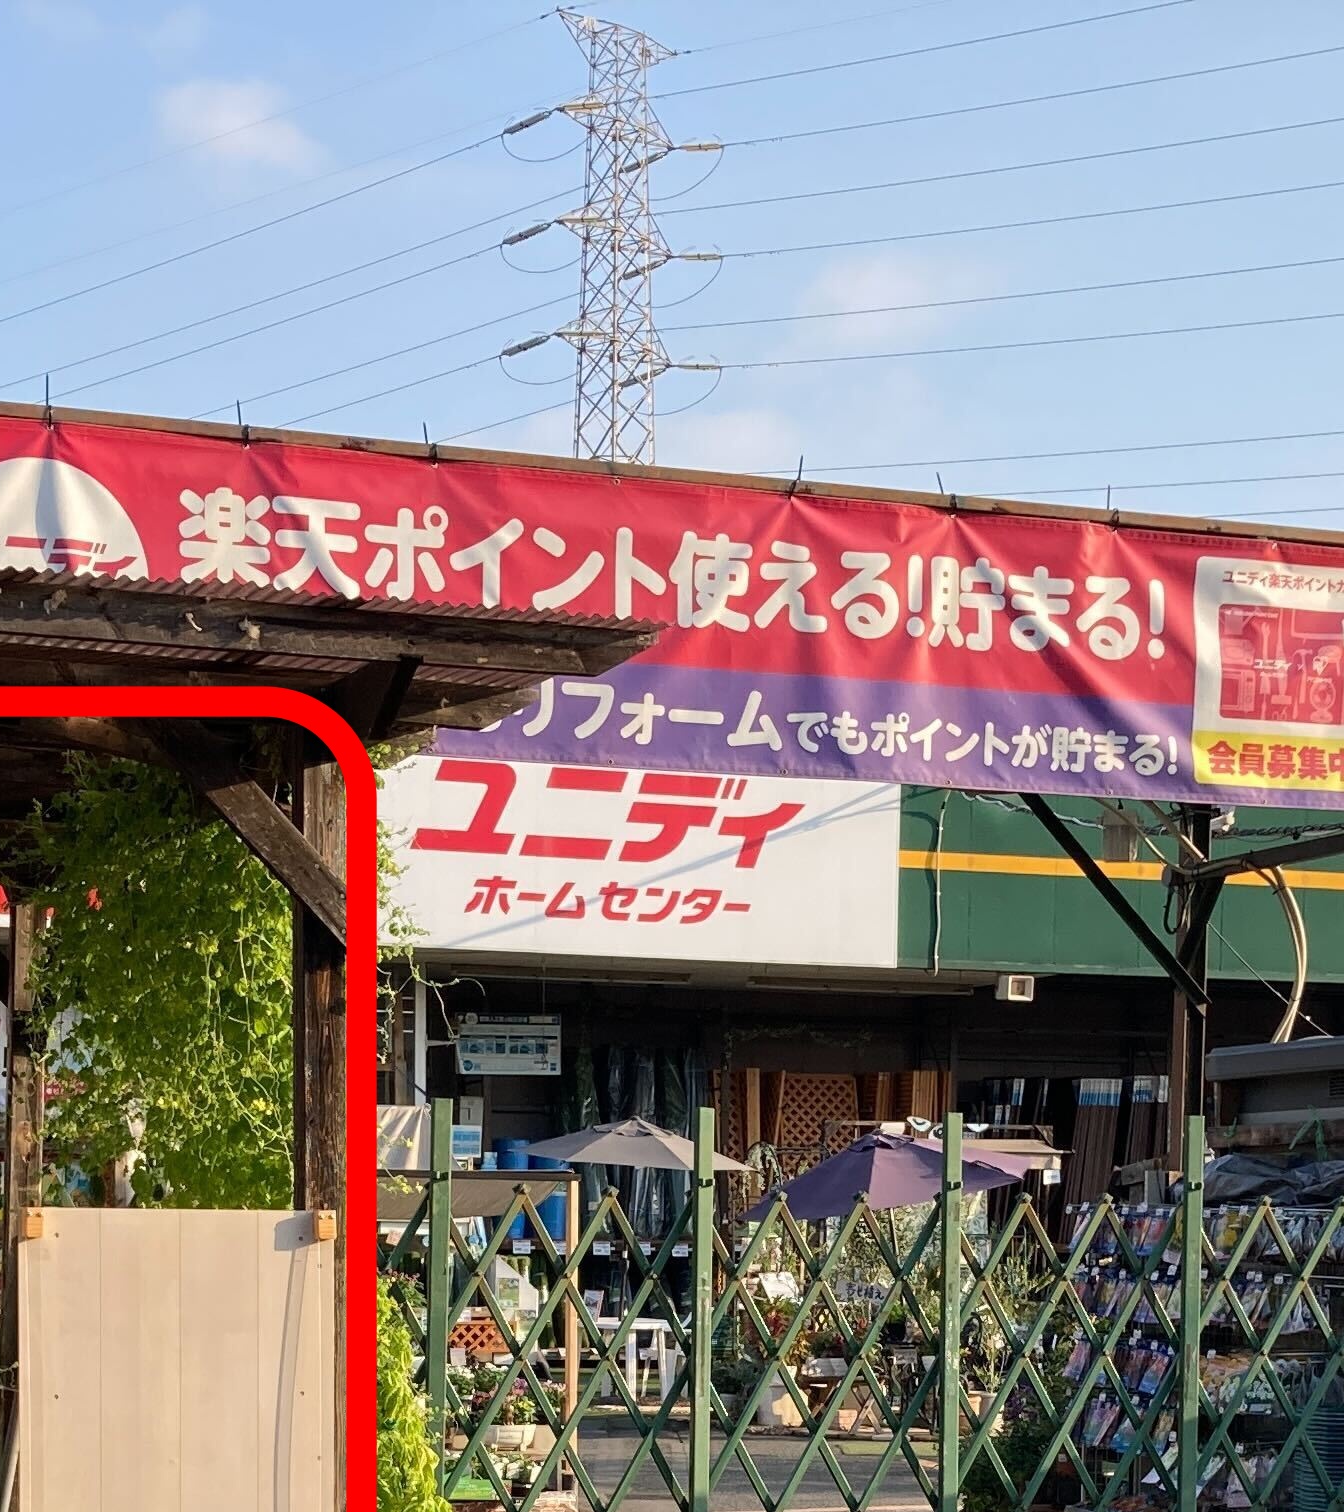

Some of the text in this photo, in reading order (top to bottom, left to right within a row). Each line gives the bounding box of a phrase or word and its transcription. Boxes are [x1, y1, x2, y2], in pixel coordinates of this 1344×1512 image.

[479, 675, 1178, 777] リフォームでもポイントが貯まる!
[410, 758, 806, 869] ユニディ
[464, 874, 751, 925] ホームセンター
